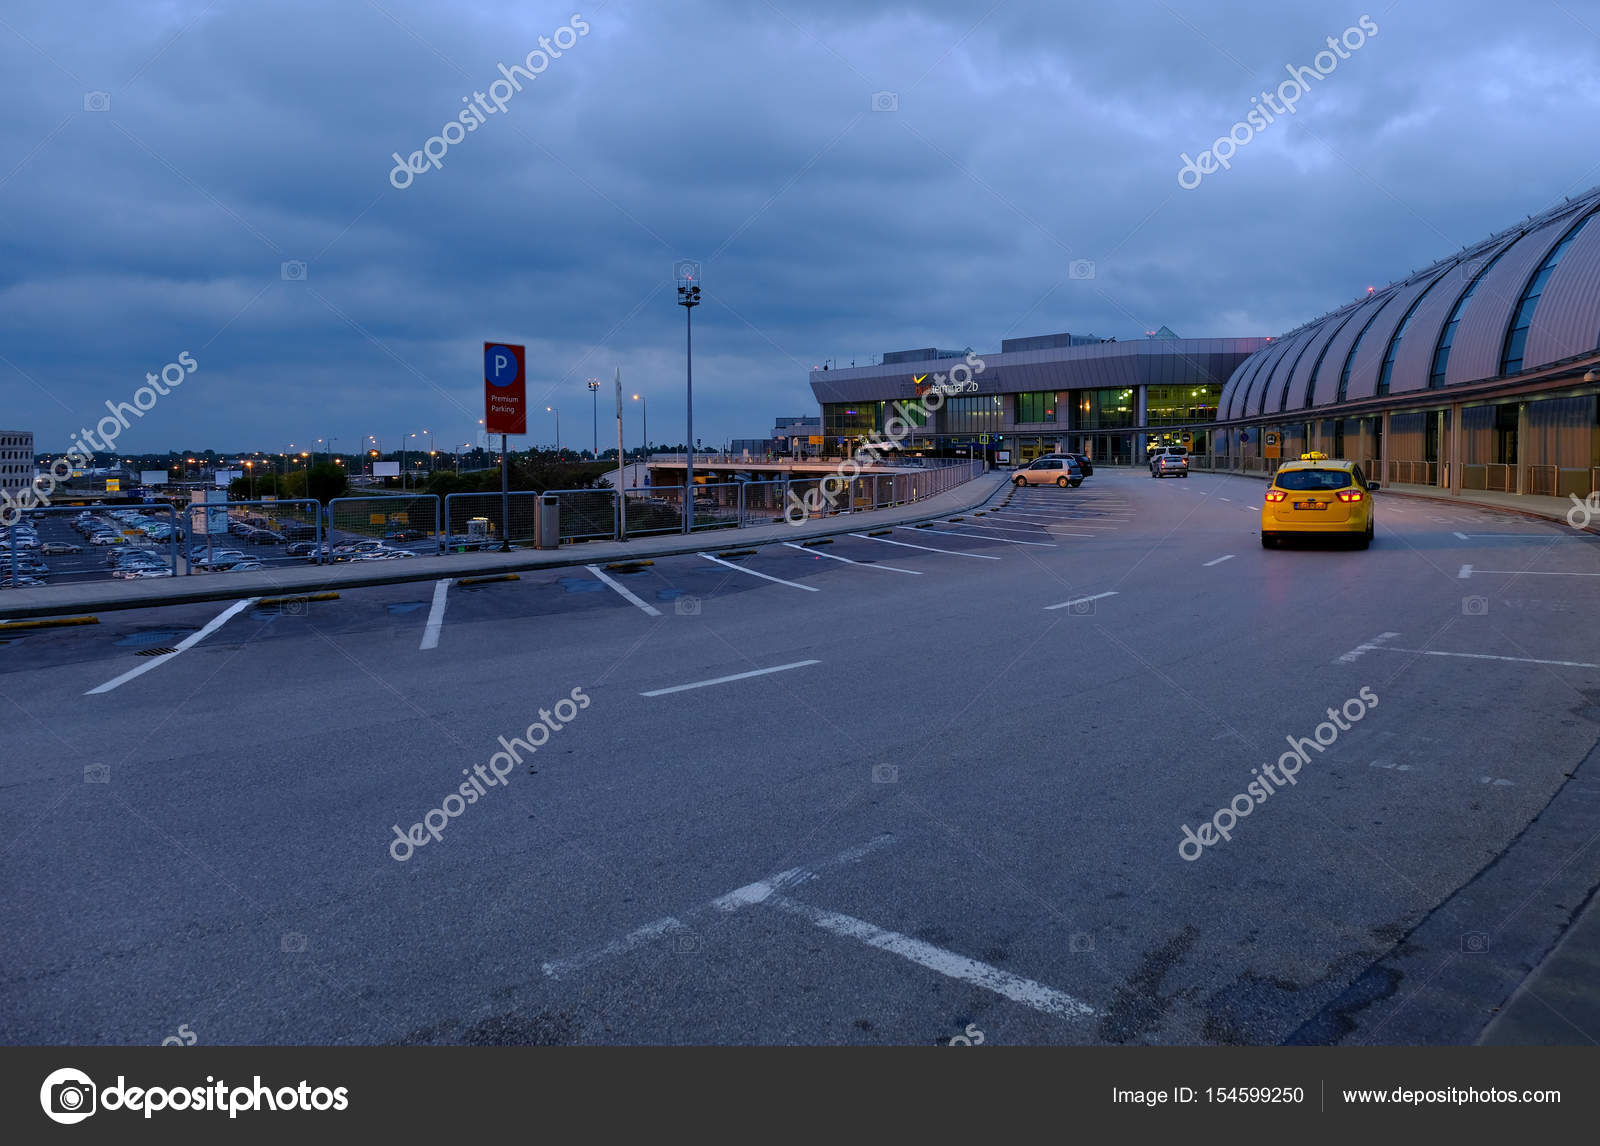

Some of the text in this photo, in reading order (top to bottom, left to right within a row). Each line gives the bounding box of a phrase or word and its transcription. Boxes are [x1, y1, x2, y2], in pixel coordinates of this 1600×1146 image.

[495, 354, 508, 377] P
[491, 394, 519, 403] Premium
[491, 405, 515, 415] Parking
